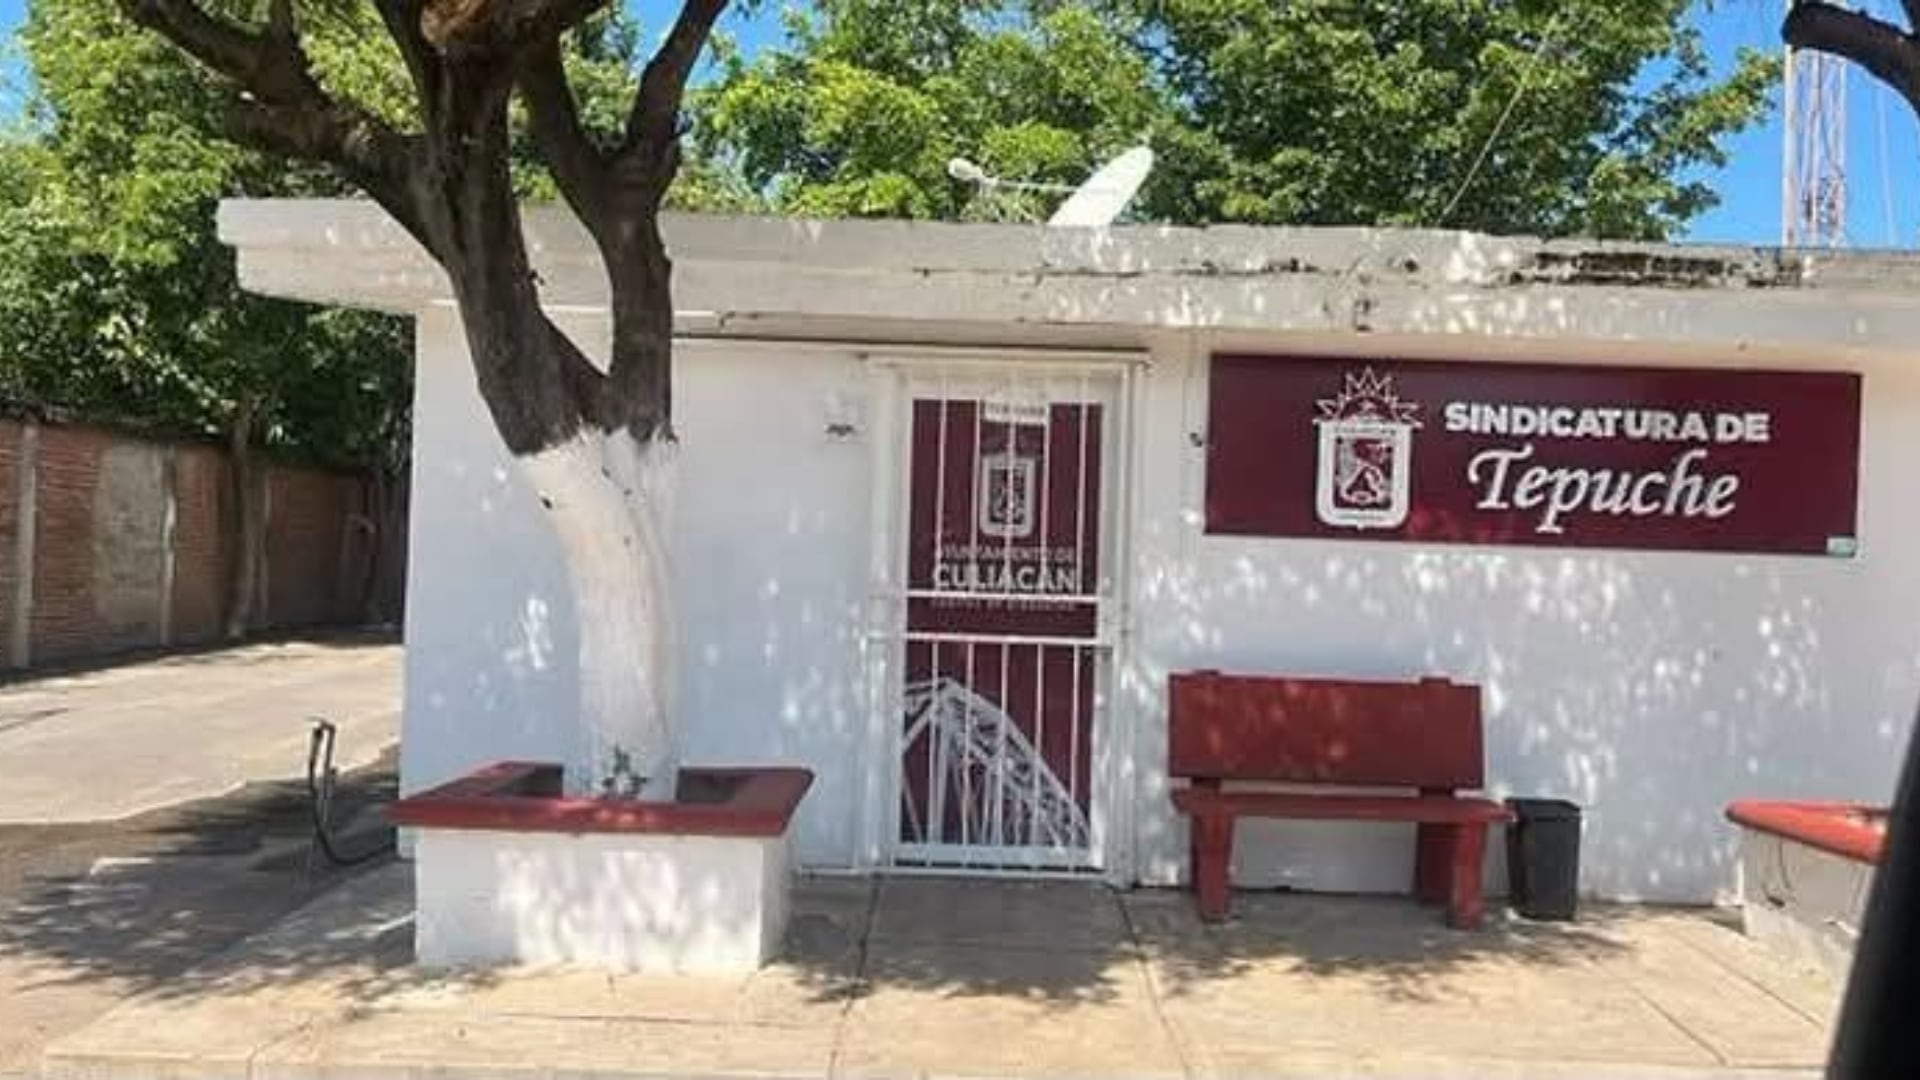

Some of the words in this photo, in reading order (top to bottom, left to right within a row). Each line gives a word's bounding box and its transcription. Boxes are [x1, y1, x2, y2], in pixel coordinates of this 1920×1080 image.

[1444, 402, 1710, 441] SINDICATURA
[1715, 413, 1771, 443] DE
[1467, 444, 1739, 533] Tepuche
[933, 545, 1051, 562] YUNTAMENTO
